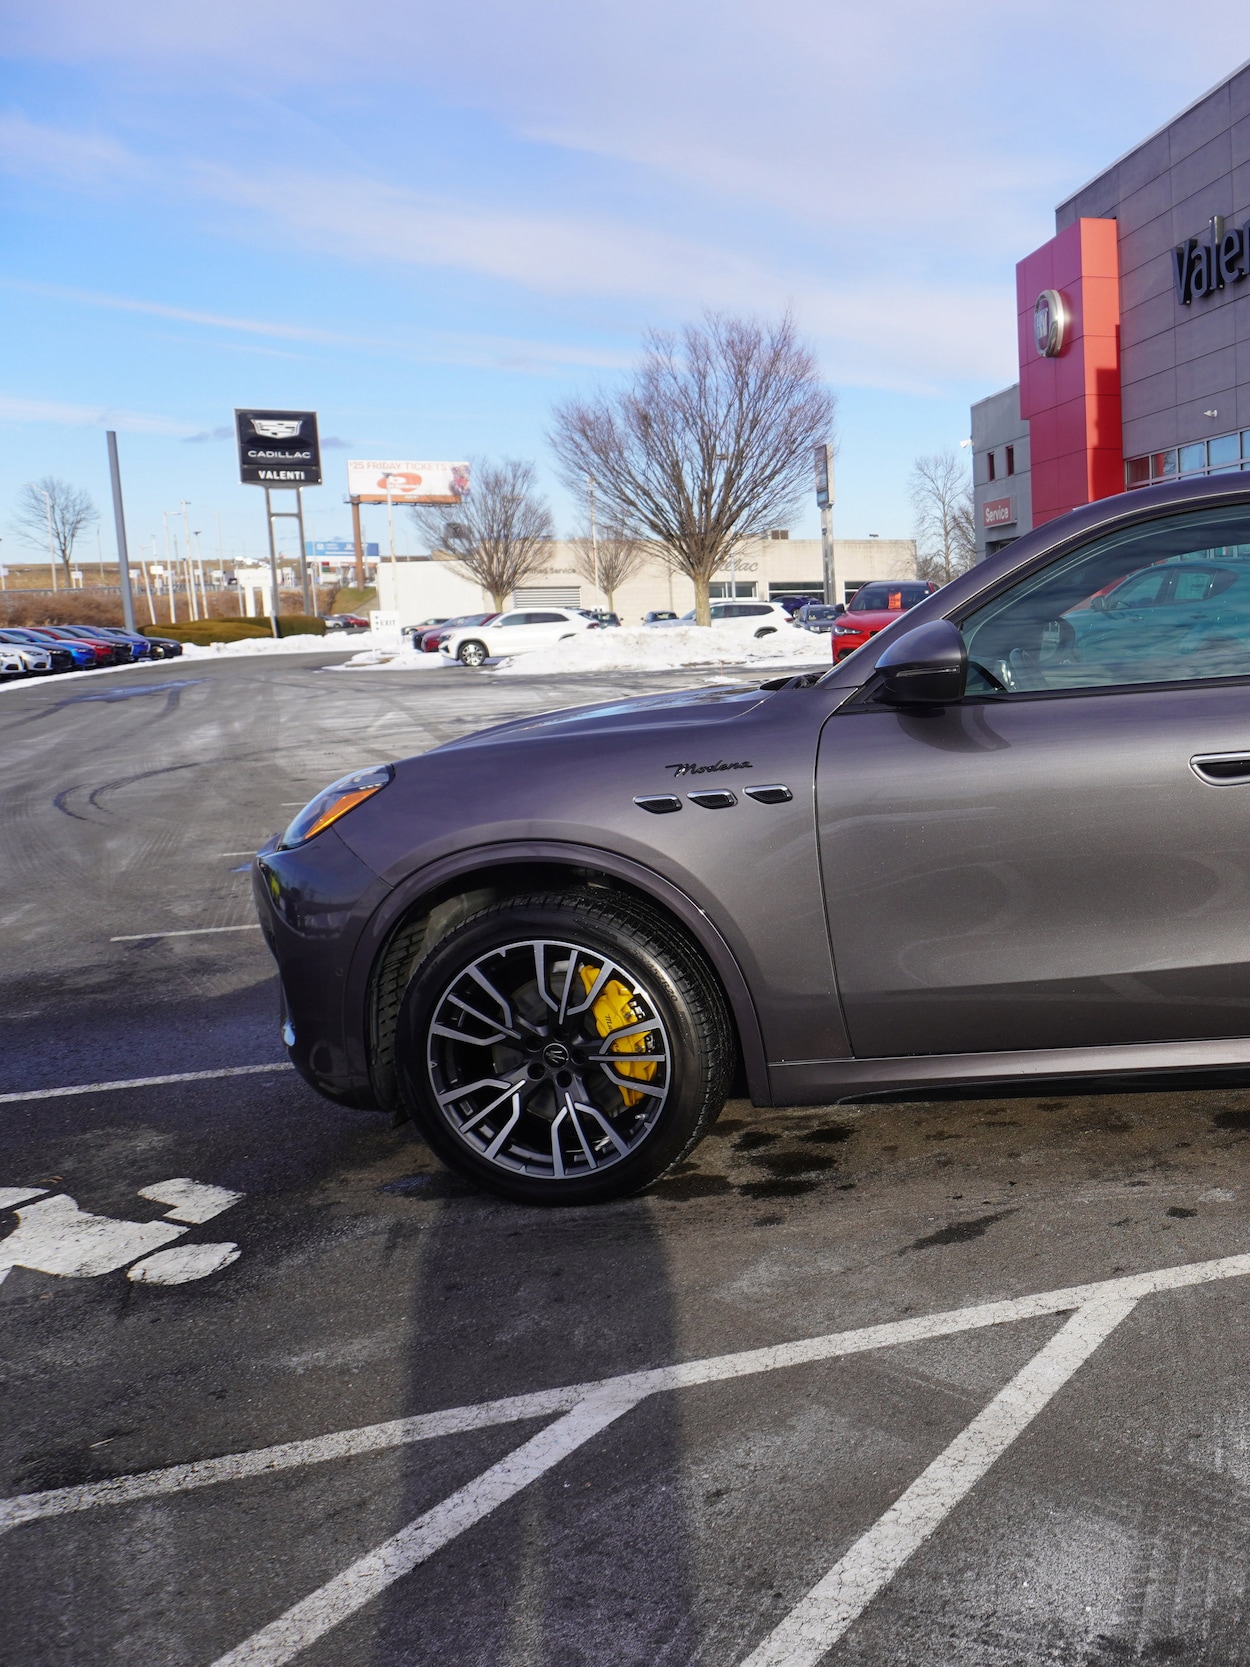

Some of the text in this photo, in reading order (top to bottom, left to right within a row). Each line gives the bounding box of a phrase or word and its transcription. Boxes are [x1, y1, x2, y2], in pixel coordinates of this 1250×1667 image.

[247, 450, 311, 459] CADILLAC
[366, 462, 401, 470] FRIDAY
[405, 462, 448, 471] TICKETS
[258, 470, 305, 480] VALENTI
[985, 505, 1009, 523] Service
[549, 567, 577, 575] Service
[665, 760, 753, 777] Modena
